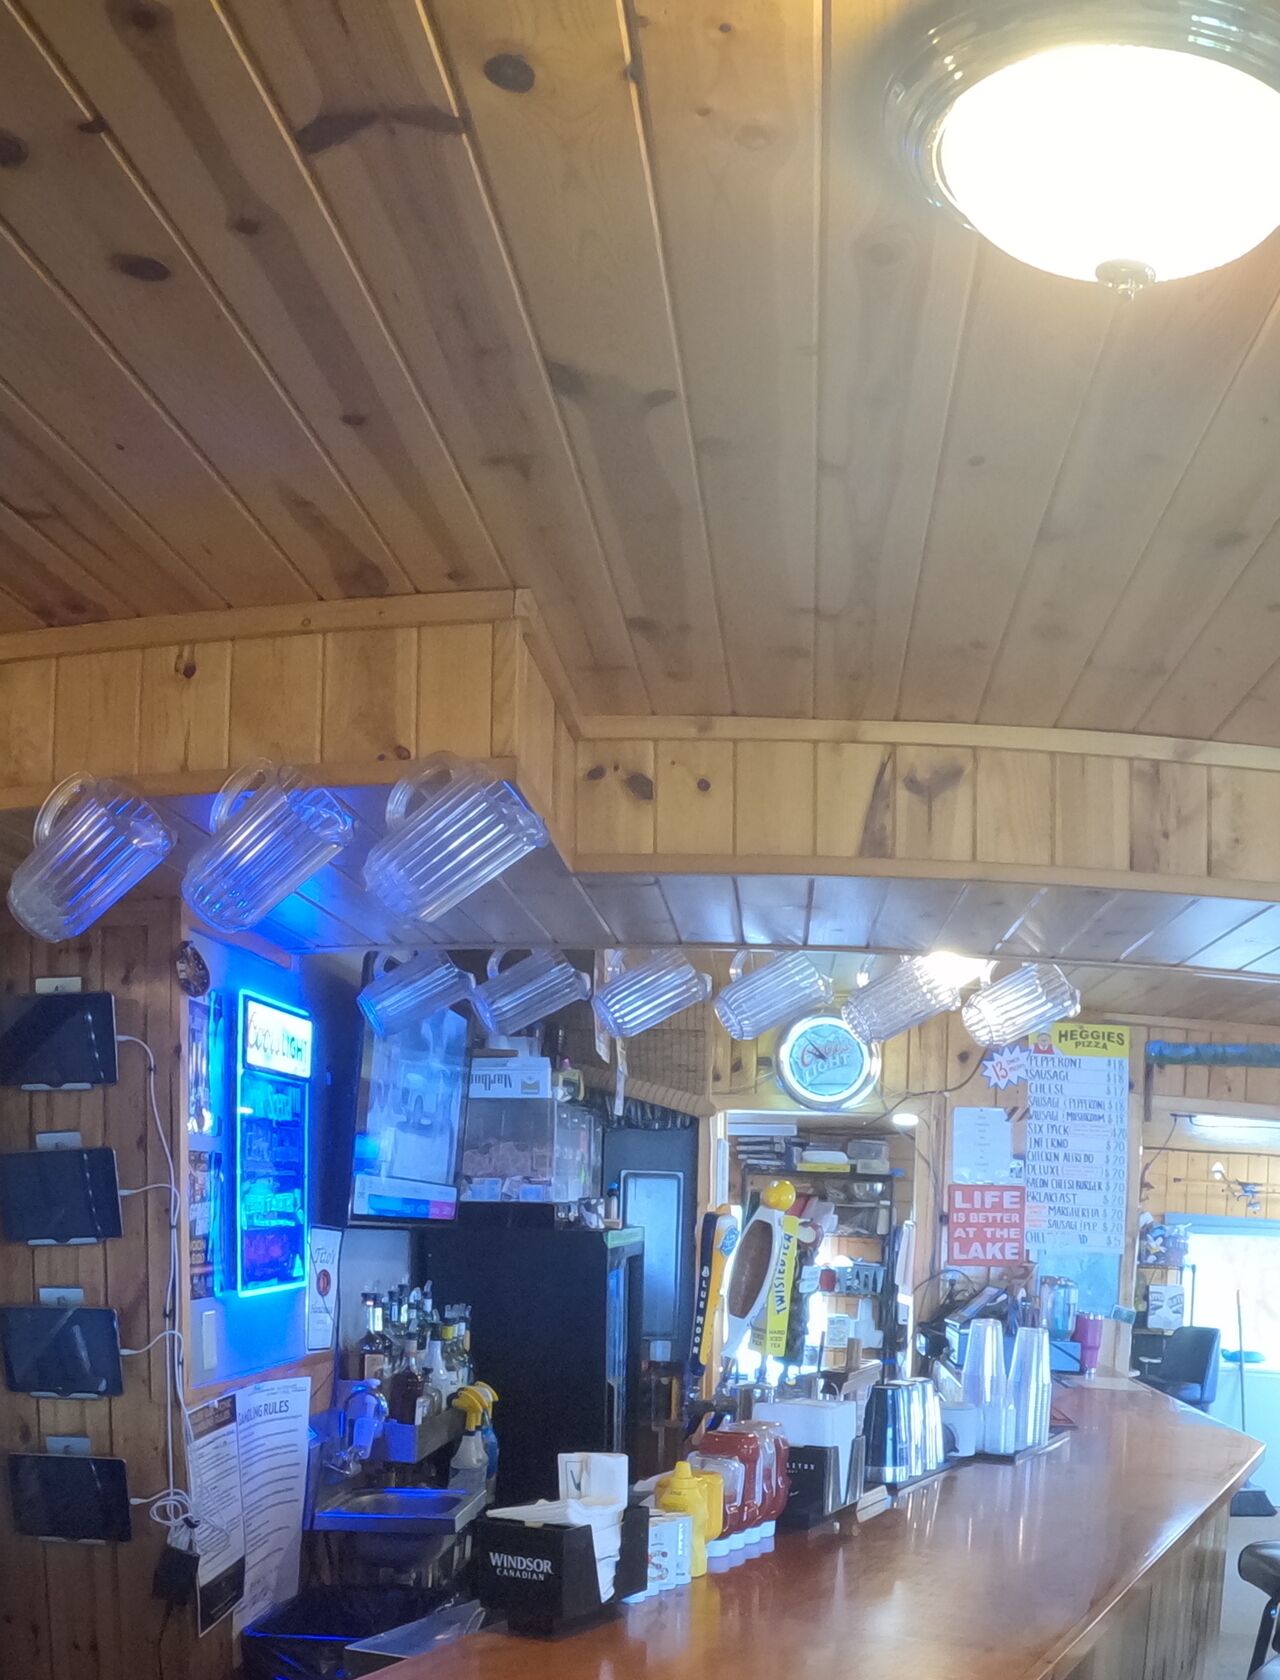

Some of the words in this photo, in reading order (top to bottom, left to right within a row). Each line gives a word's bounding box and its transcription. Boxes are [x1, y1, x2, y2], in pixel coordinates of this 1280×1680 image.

[1058, 1029, 1125, 1046] HEGGIES
[1075, 1041, 1108, 1050] PIZZA
[992, 1061, 1008, 1081] 13
[1028, 1069, 1069, 1081] SAUSAGE
[1028, 1123, 1044, 1135] SIX
[1046, 1124, 1070, 1135] PACK
[954, 1190, 1020, 1209] LIFE
[953, 1212, 966, 1223] IS
[970, 1213, 1020, 1223] BETTER
[953, 1228, 977, 1238] AT
[983, 1228, 1020, 1238] THE
[953, 1242, 1020, 1260] LAKE
[699, 1266, 710, 1309] BLUE
[693, 1316, 704, 1354] MOON
[263, 1400, 290, 1416] RULES
[489, 1552, 555, 1575] WINDSOR
[496, 1568, 545, 1581] CANADIAN
